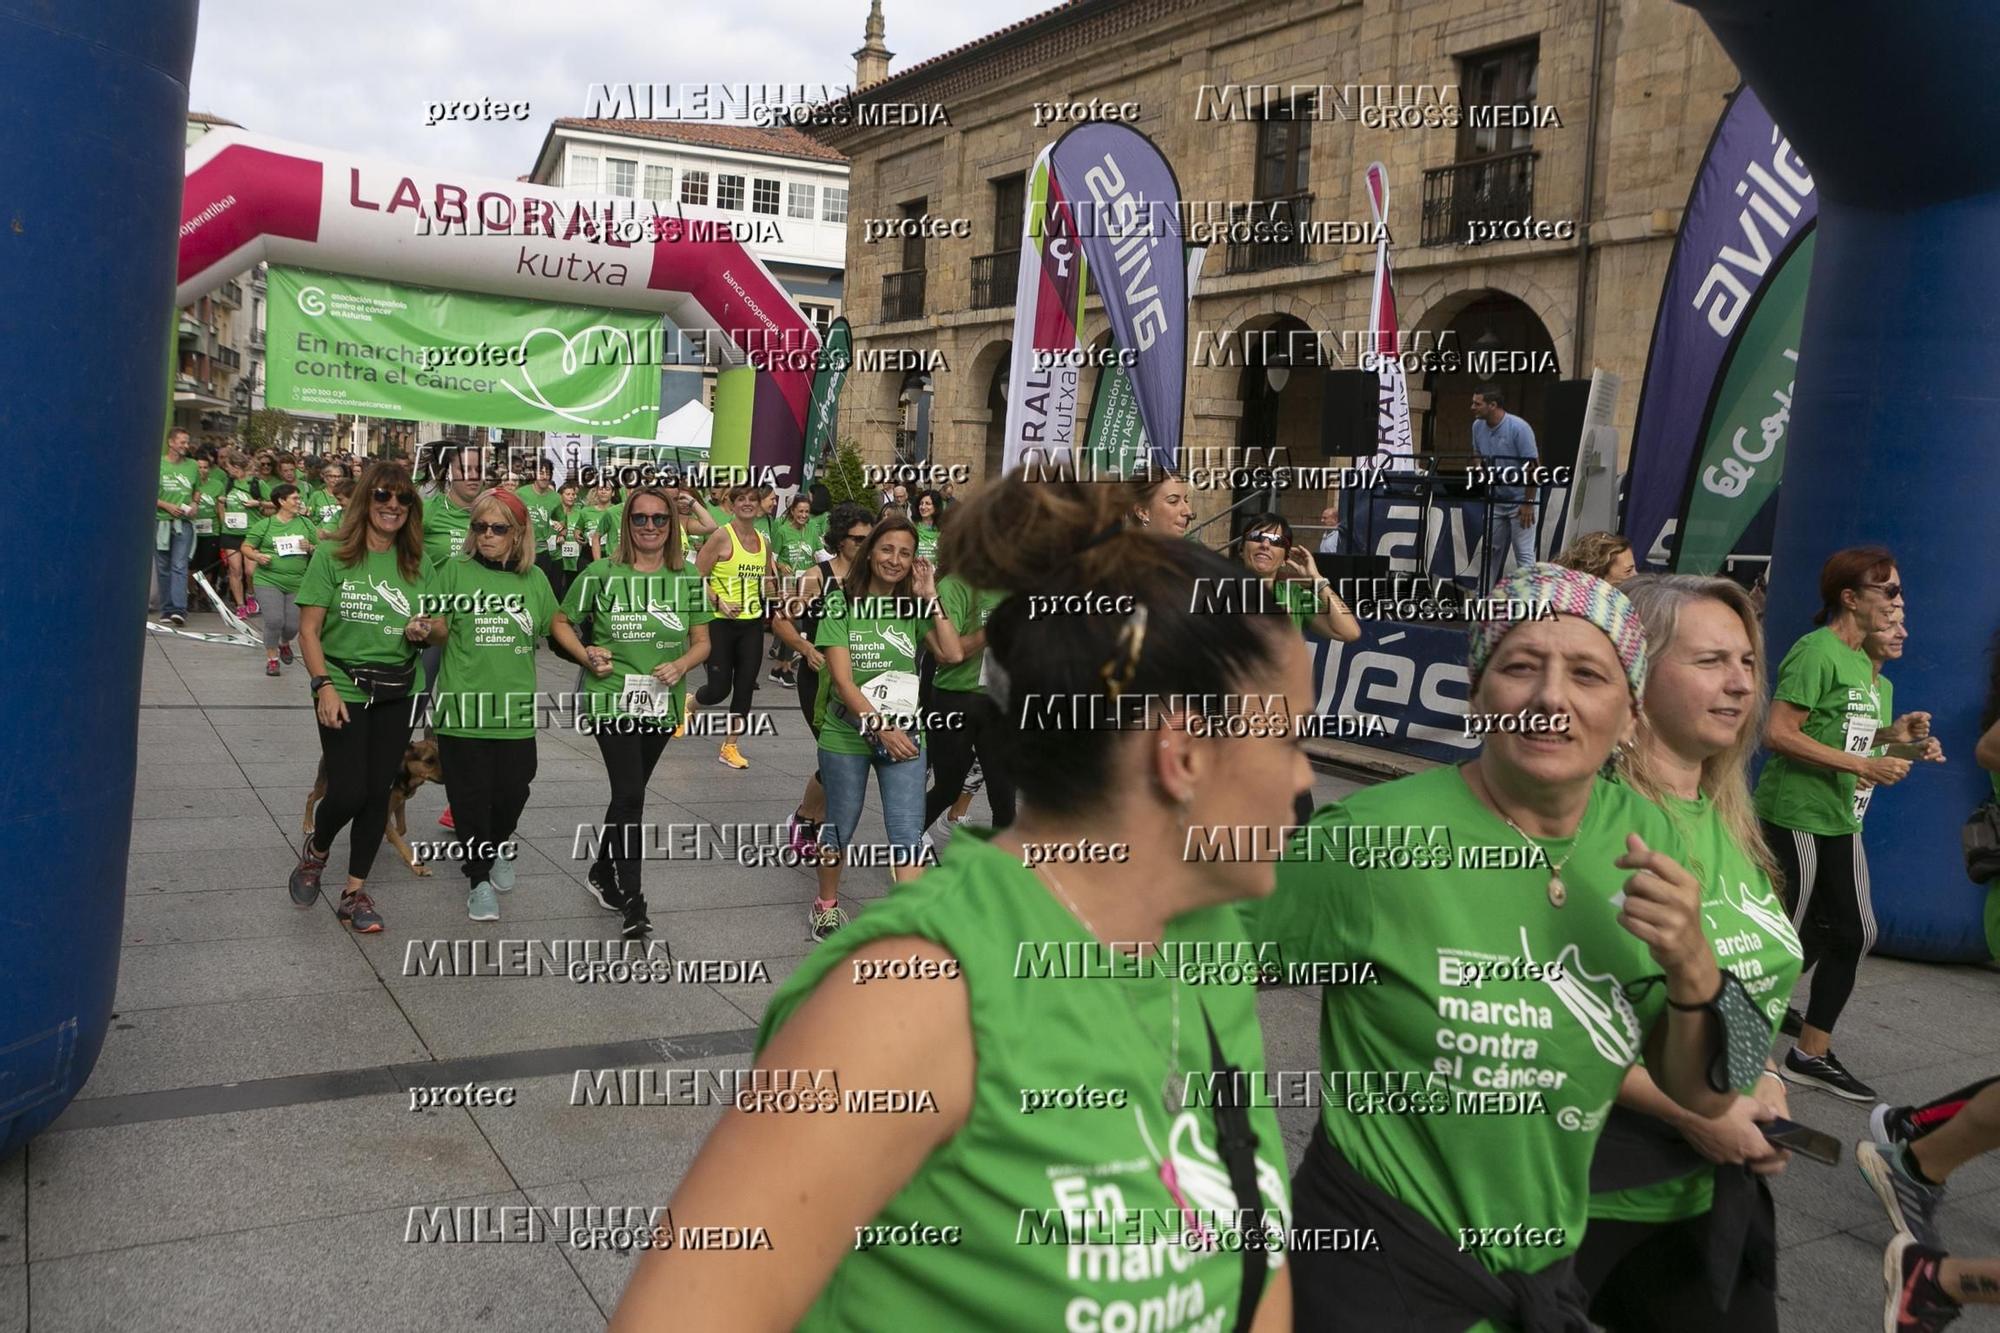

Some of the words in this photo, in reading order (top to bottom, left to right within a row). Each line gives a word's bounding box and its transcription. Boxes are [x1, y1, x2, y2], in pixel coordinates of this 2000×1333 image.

[350, 167, 632, 249] LABORAL
[516, 246, 628, 286] kutxa
[722, 270, 745, 299] banca
[331, 301, 355, 312] contra
[356, 304, 364, 312] el
[331, 310, 341, 318] en
[341, 311, 373, 322] Asturias
[297, 332, 328, 354] En
[335, 340, 428, 366] marcha
[295, 360, 377, 382] contra
[384, 366, 408, 385] el
[415, 369, 497, 394] cáncer
[1052, 371, 1077, 443] kutxa
[1098, 378, 1121, 451] asociación
[1108, 409, 1124, 454] contra
[1120, 394, 1129, 407] el
[1120, 439, 1130, 457] en
[1703, 457, 1755, 498] El
[738, 563, 766, 573] HAPPY
[342, 581, 355, 591] En
[341, 592, 378, 602] marcha
[340, 600, 373, 611] contra
[340, 610, 349, 618] el
[351, 610, 385, 621] cáncer
[475, 615, 509, 625] marcha
[611, 612, 648, 621] marcha
[475, 625, 504, 634] contra
[611, 621, 643, 631] contra
[475, 634, 484, 643] el
[486, 634, 515, 643] cáncer
[612, 631, 620, 639] el
[622, 630, 656, 639] cáncer
[850, 632, 862, 642] En
[850, 642, 885, 650] marcha
[851, 651, 880, 660] contra
[861, 659, 893, 669] cáncer
[1848, 690, 1862, 700] En
[1851, 735, 1868, 752] 216
[1439, 995, 1553, 1029] marcha
[1436, 1028, 1539, 1060] contra
[1434, 1056, 1463, 1080] el
[1472, 1062, 1568, 1090] cáncer
[1053, 1176, 1128, 1230] En
